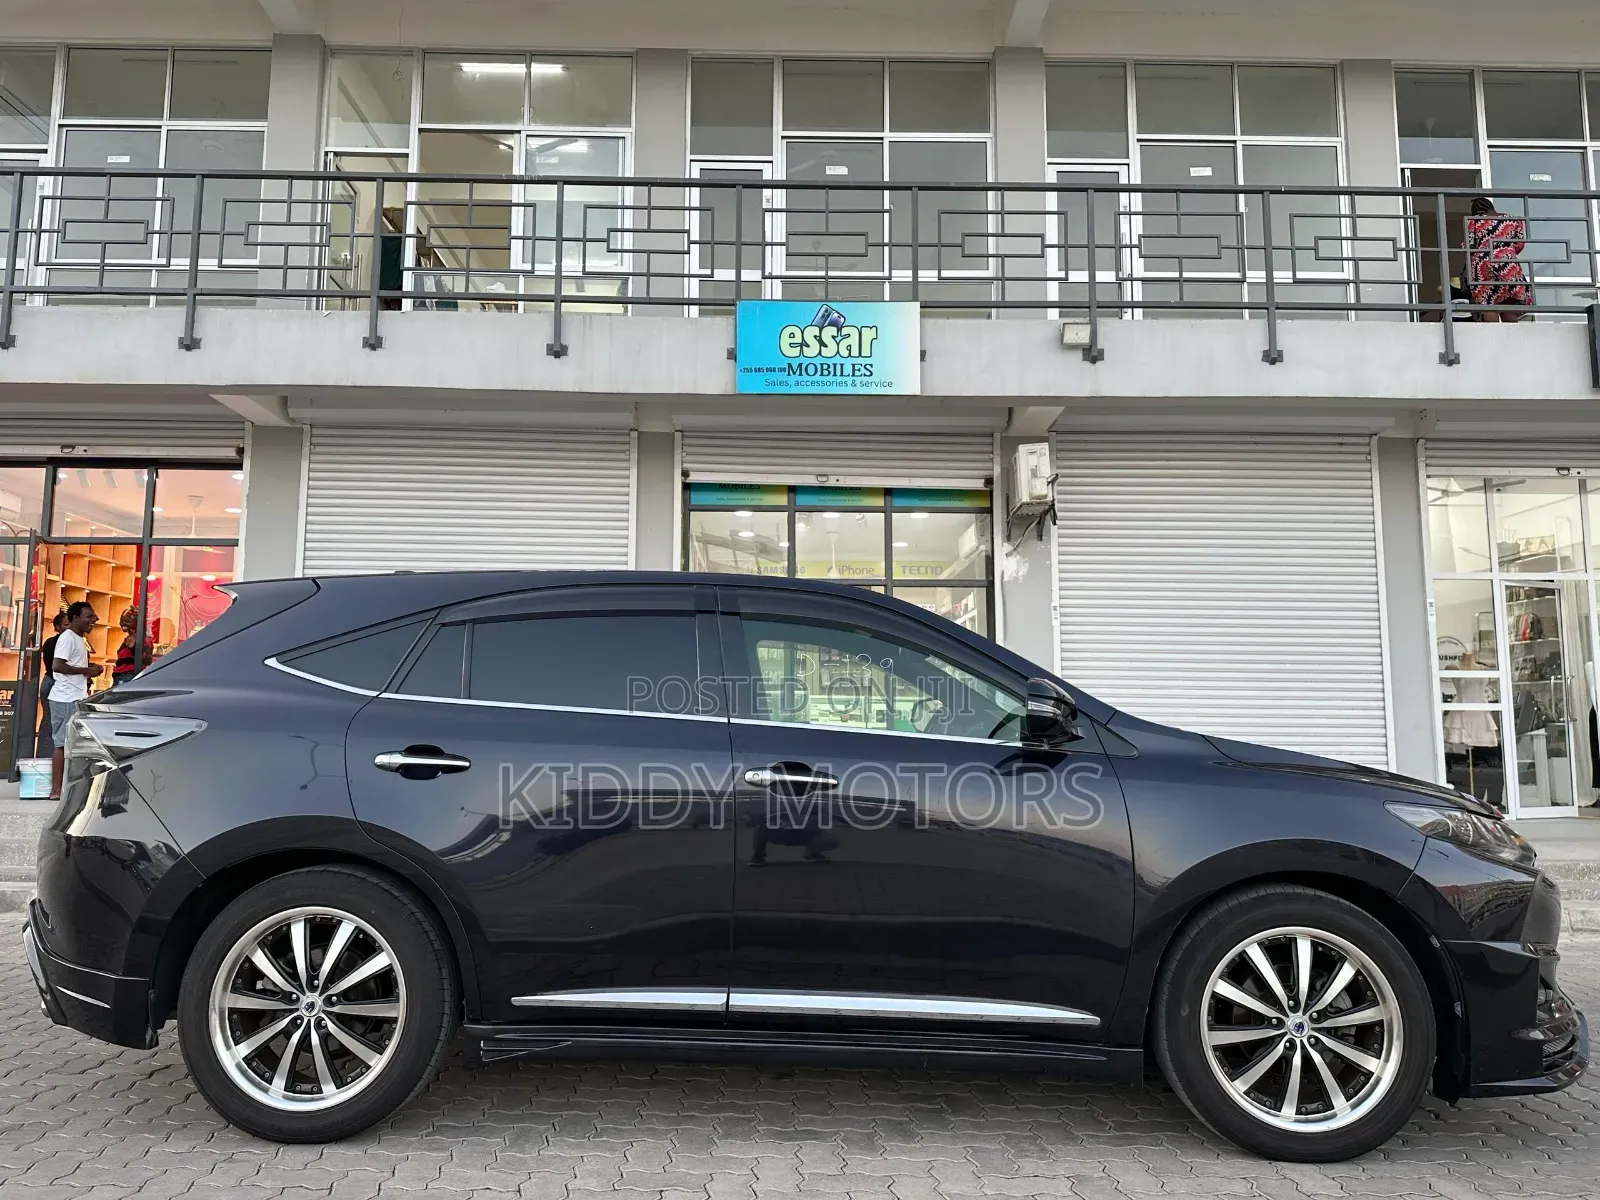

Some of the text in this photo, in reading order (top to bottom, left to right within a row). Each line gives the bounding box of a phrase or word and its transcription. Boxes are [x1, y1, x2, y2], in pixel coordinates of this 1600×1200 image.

[779, 325, 877, 358] essar
[786, 362, 873, 377] MOBILES
[764, 378, 893, 388] Sales, accessories & service
[838, 564, 875, 575] iPhone
[901, 565, 943, 575] TECNO
